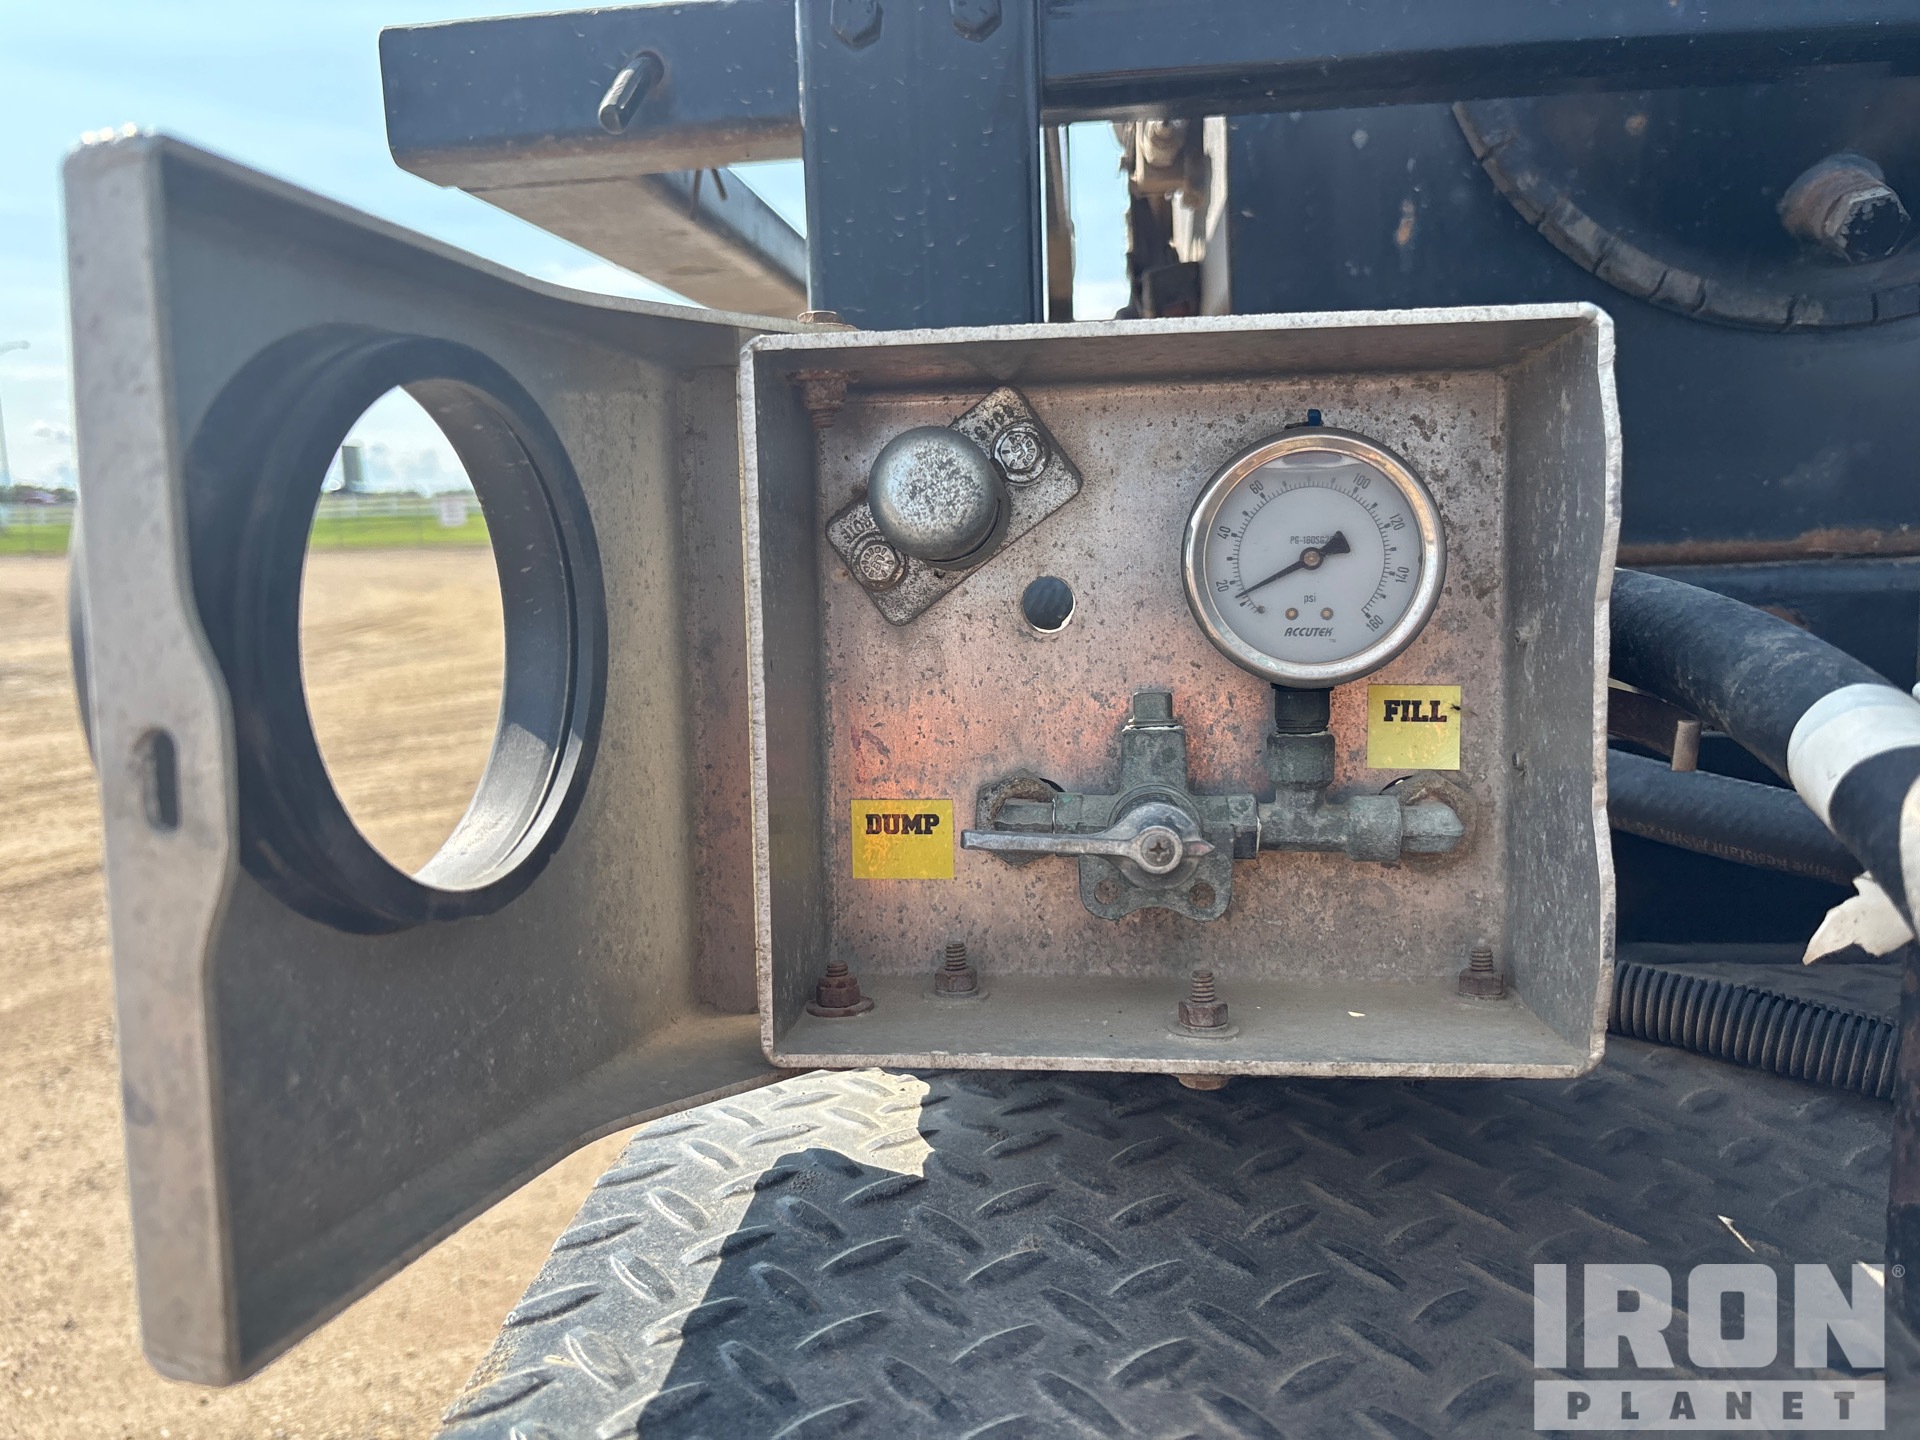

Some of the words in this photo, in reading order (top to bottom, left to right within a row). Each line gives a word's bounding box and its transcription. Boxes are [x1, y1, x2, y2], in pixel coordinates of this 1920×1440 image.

[1249, 479, 1265, 495] 60
[1352, 472, 1372, 490] 100
[1389, 513, 1406, 531] 120
[1216, 525, 1232, 540] 40
[1395, 566, 1410, 584] 140
[1215, 579, 1229, 593] 20
[1303, 594, 1316, 604] psi
[1366, 614, 1385, 632] 160
[1284, 627, 1334, 638] ACCUTEK
[1383, 699, 1448, 723] FILL
[865, 813, 940, 835] DUMP
